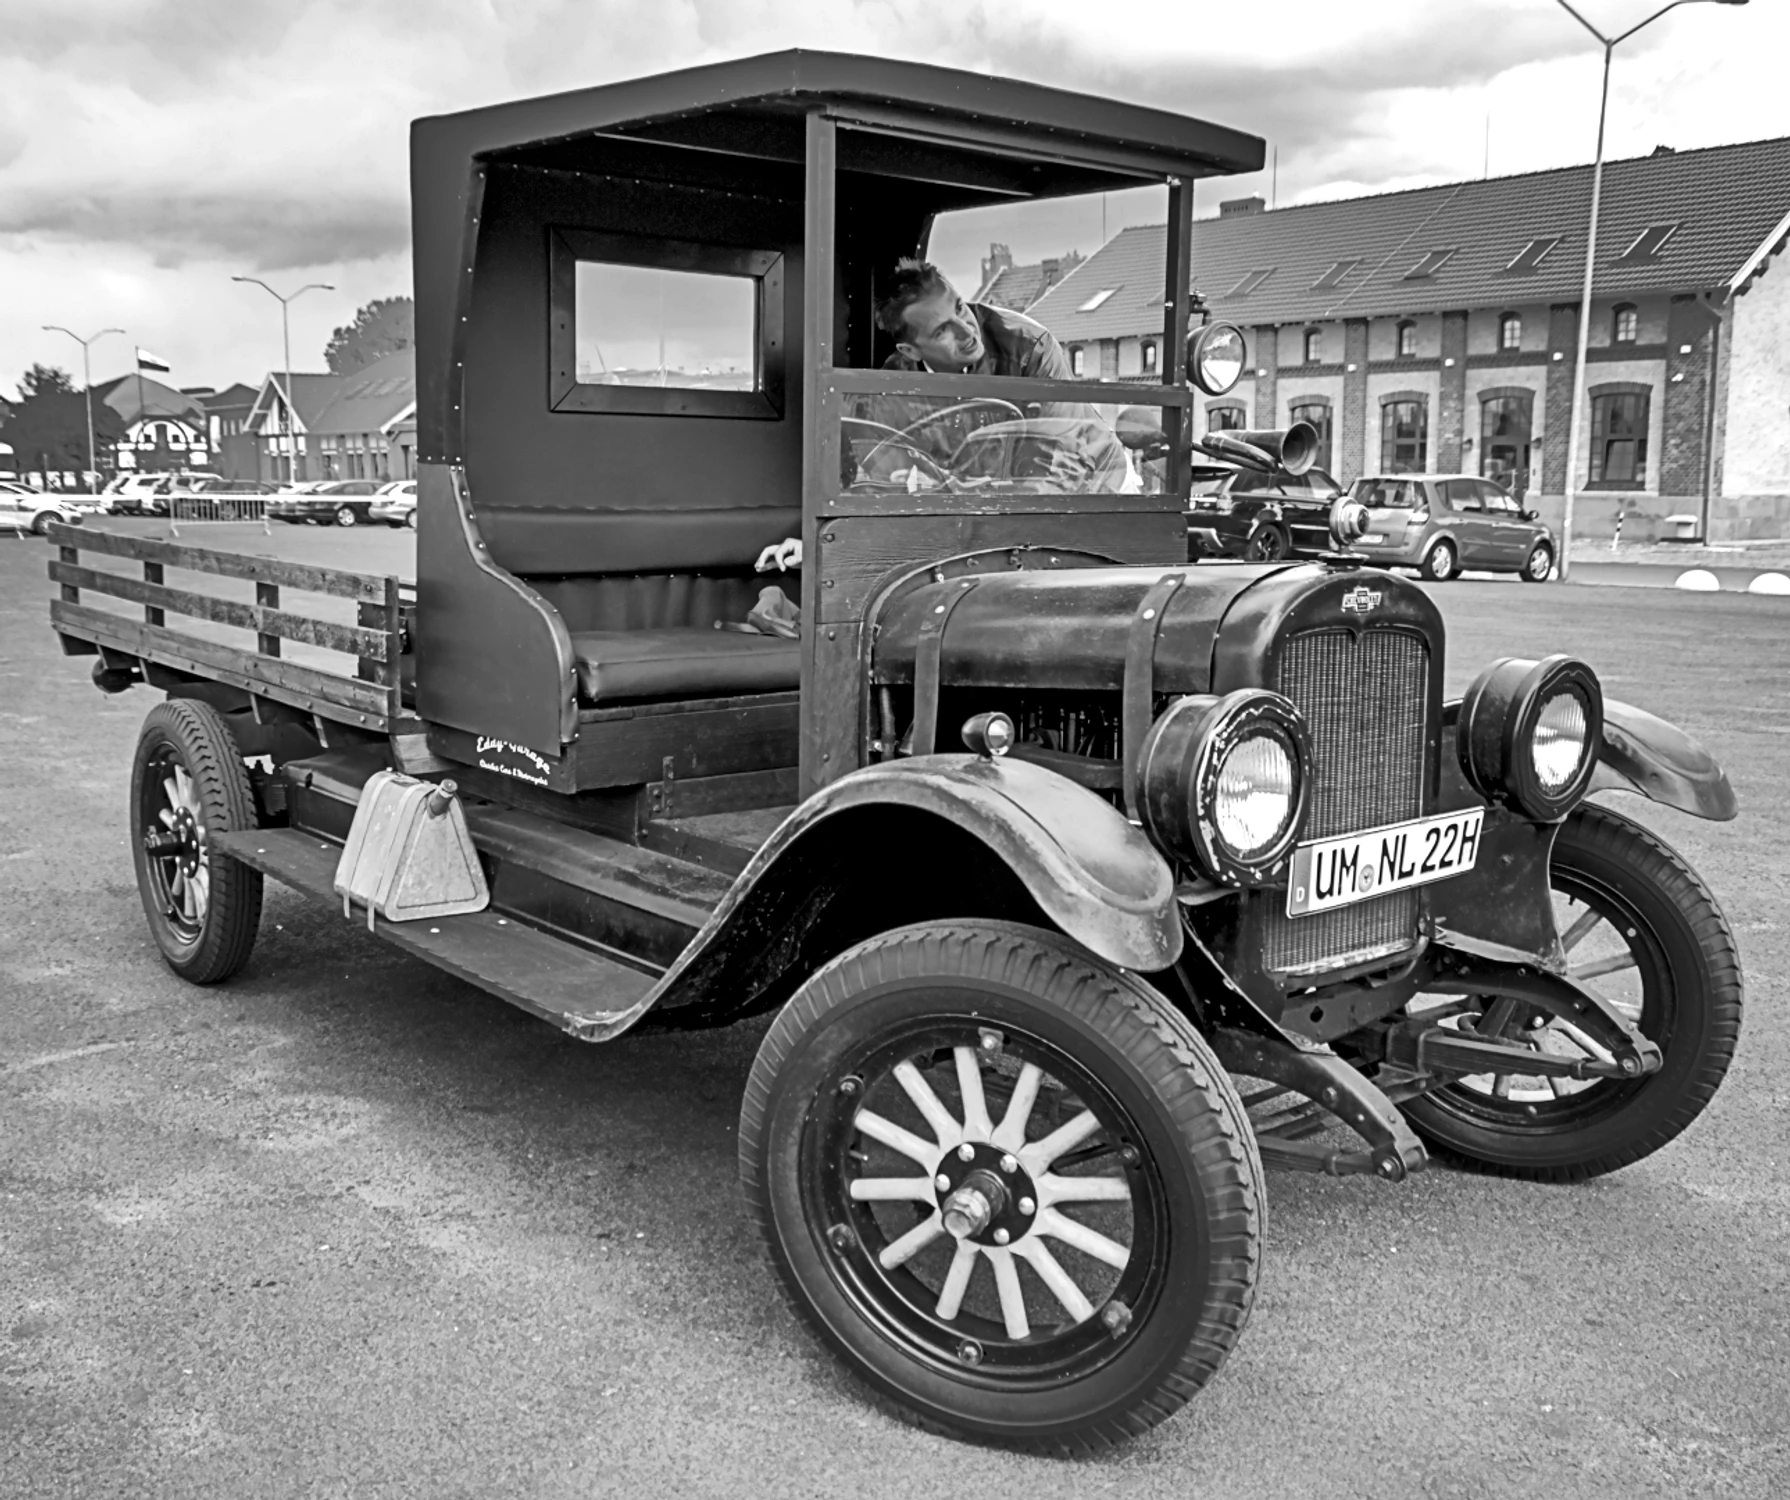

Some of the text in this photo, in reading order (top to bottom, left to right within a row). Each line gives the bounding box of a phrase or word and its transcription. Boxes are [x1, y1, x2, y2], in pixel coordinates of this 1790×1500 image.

[1316, 818, 1480, 900] UM NL 22H
[1296, 886, 1305, 903] D
